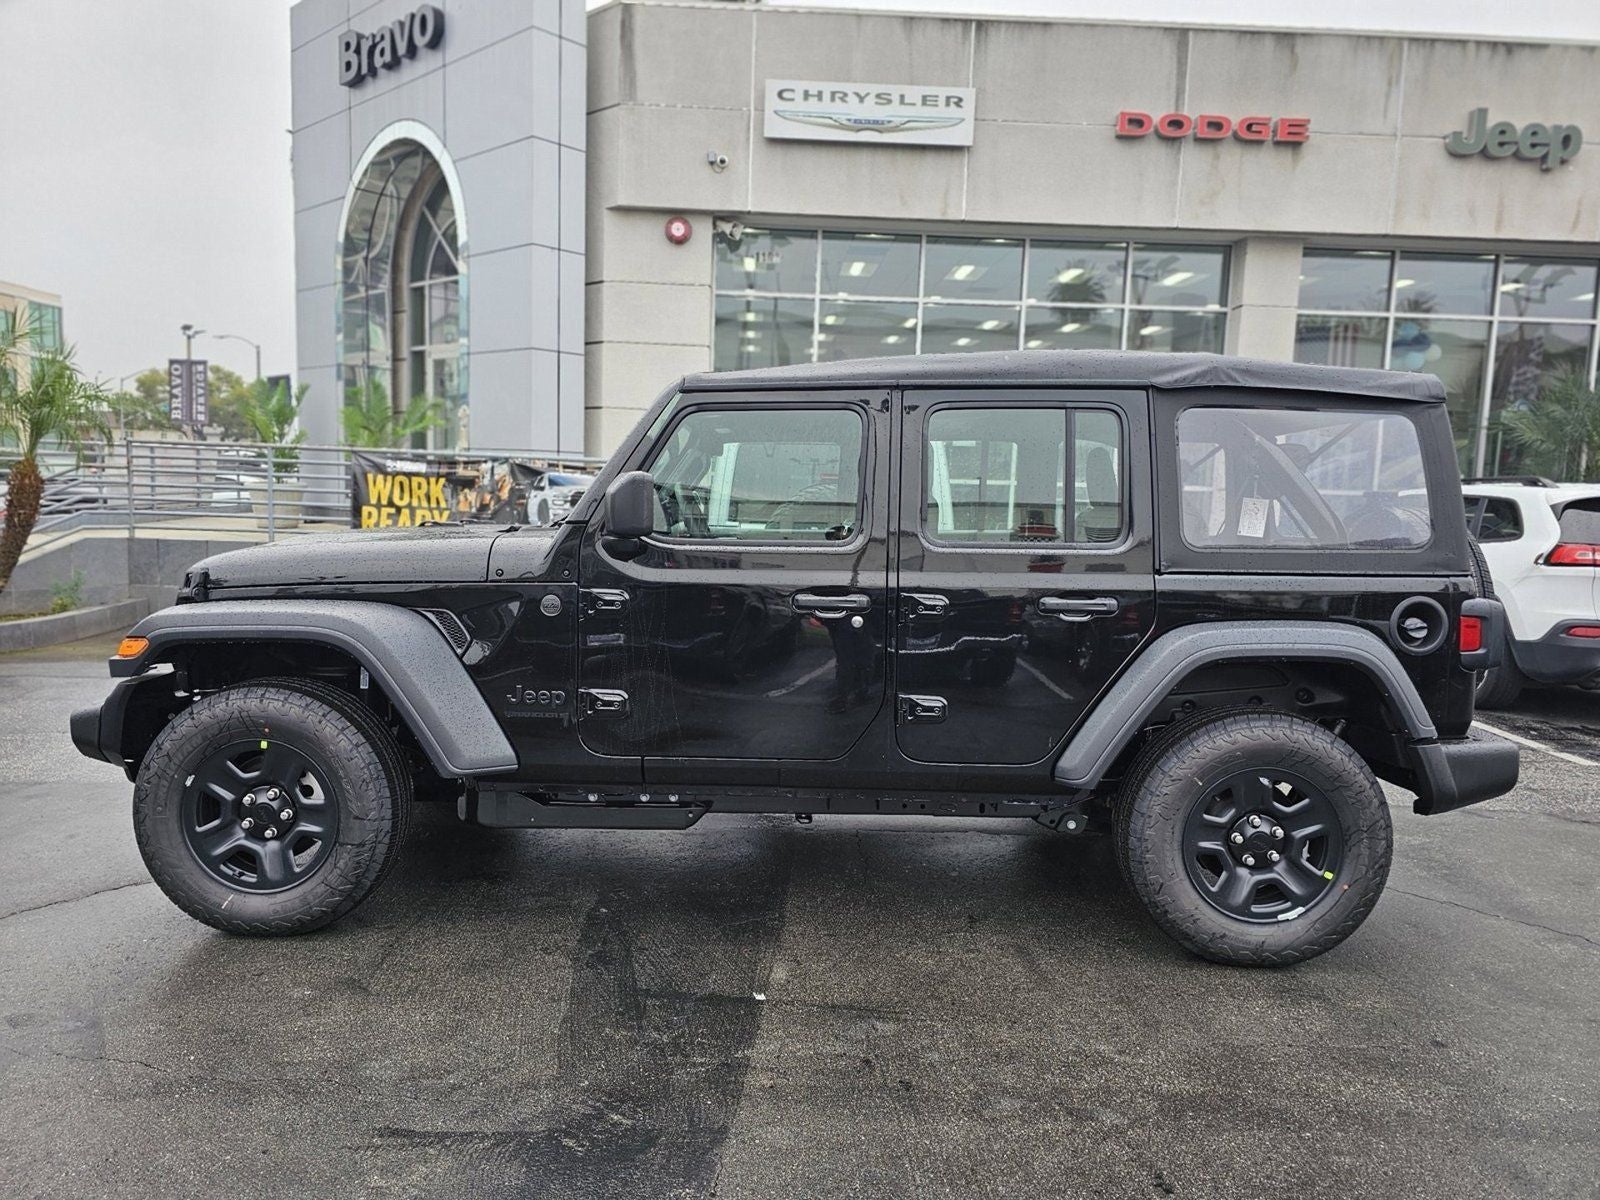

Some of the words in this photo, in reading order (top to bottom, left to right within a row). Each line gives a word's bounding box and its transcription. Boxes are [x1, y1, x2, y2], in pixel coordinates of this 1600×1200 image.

[338, 4, 445, 87] Bravo
[776, 87, 965, 109] CHRYSLER
[1115, 110, 1312, 143] DODGE
[1444, 107, 1584, 172] Jeep
[170, 364, 182, 419] BRAVO
[196, 364, 206, 421] SERVICE
[366, 472, 447, 509] WORK
[505, 684, 567, 709] Jeep
